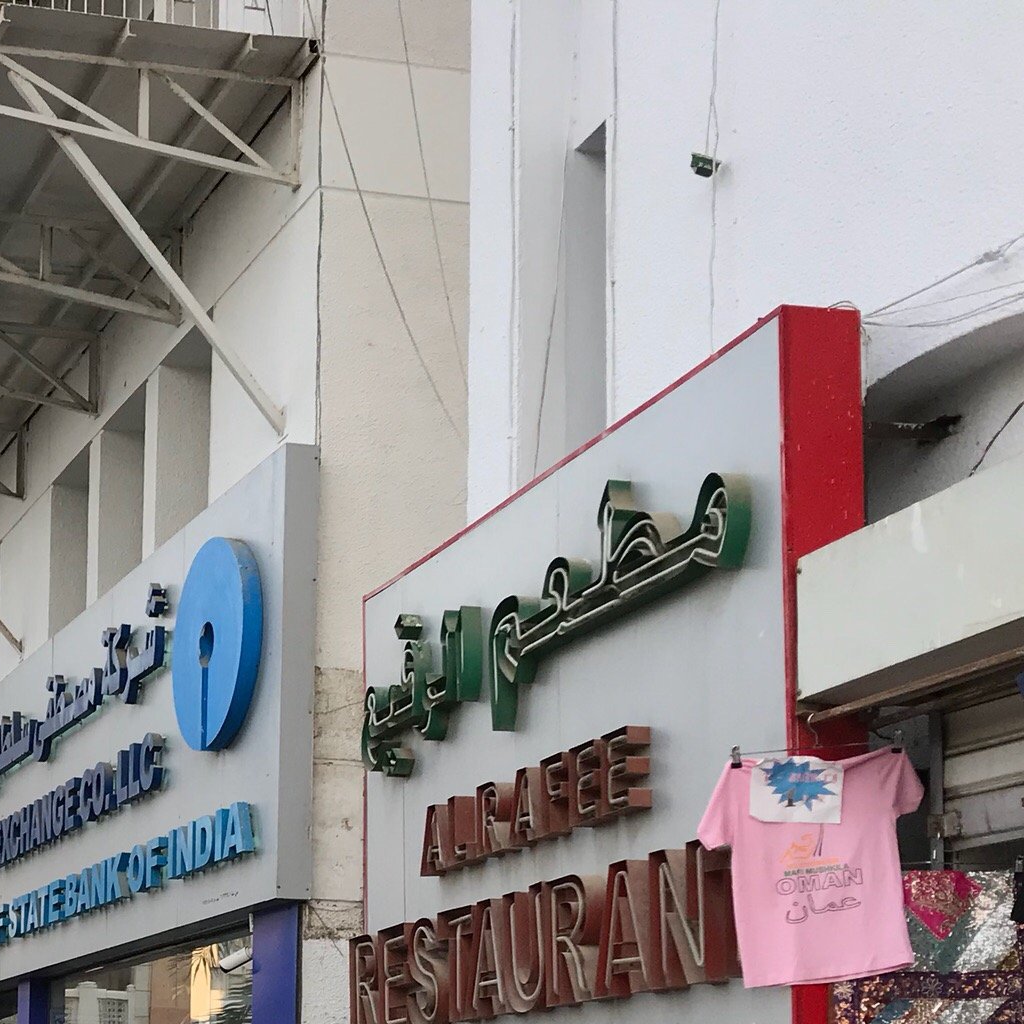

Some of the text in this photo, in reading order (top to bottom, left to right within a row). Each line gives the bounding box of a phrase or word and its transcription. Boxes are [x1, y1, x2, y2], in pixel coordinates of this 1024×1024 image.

[100, 583, 168, 705] شركة
[489, 472, 752, 732] مطعم
[116, 732, 167, 805] LLC
[7, 878, 67, 939] STATE
[64, 851, 131, 918] BANK
[126, 836, 169, 893] OF
[167, 801, 257, 880] INDIA
[775, 867, 864, 896] OMAN
[785, 894, 863, 925] عمان
